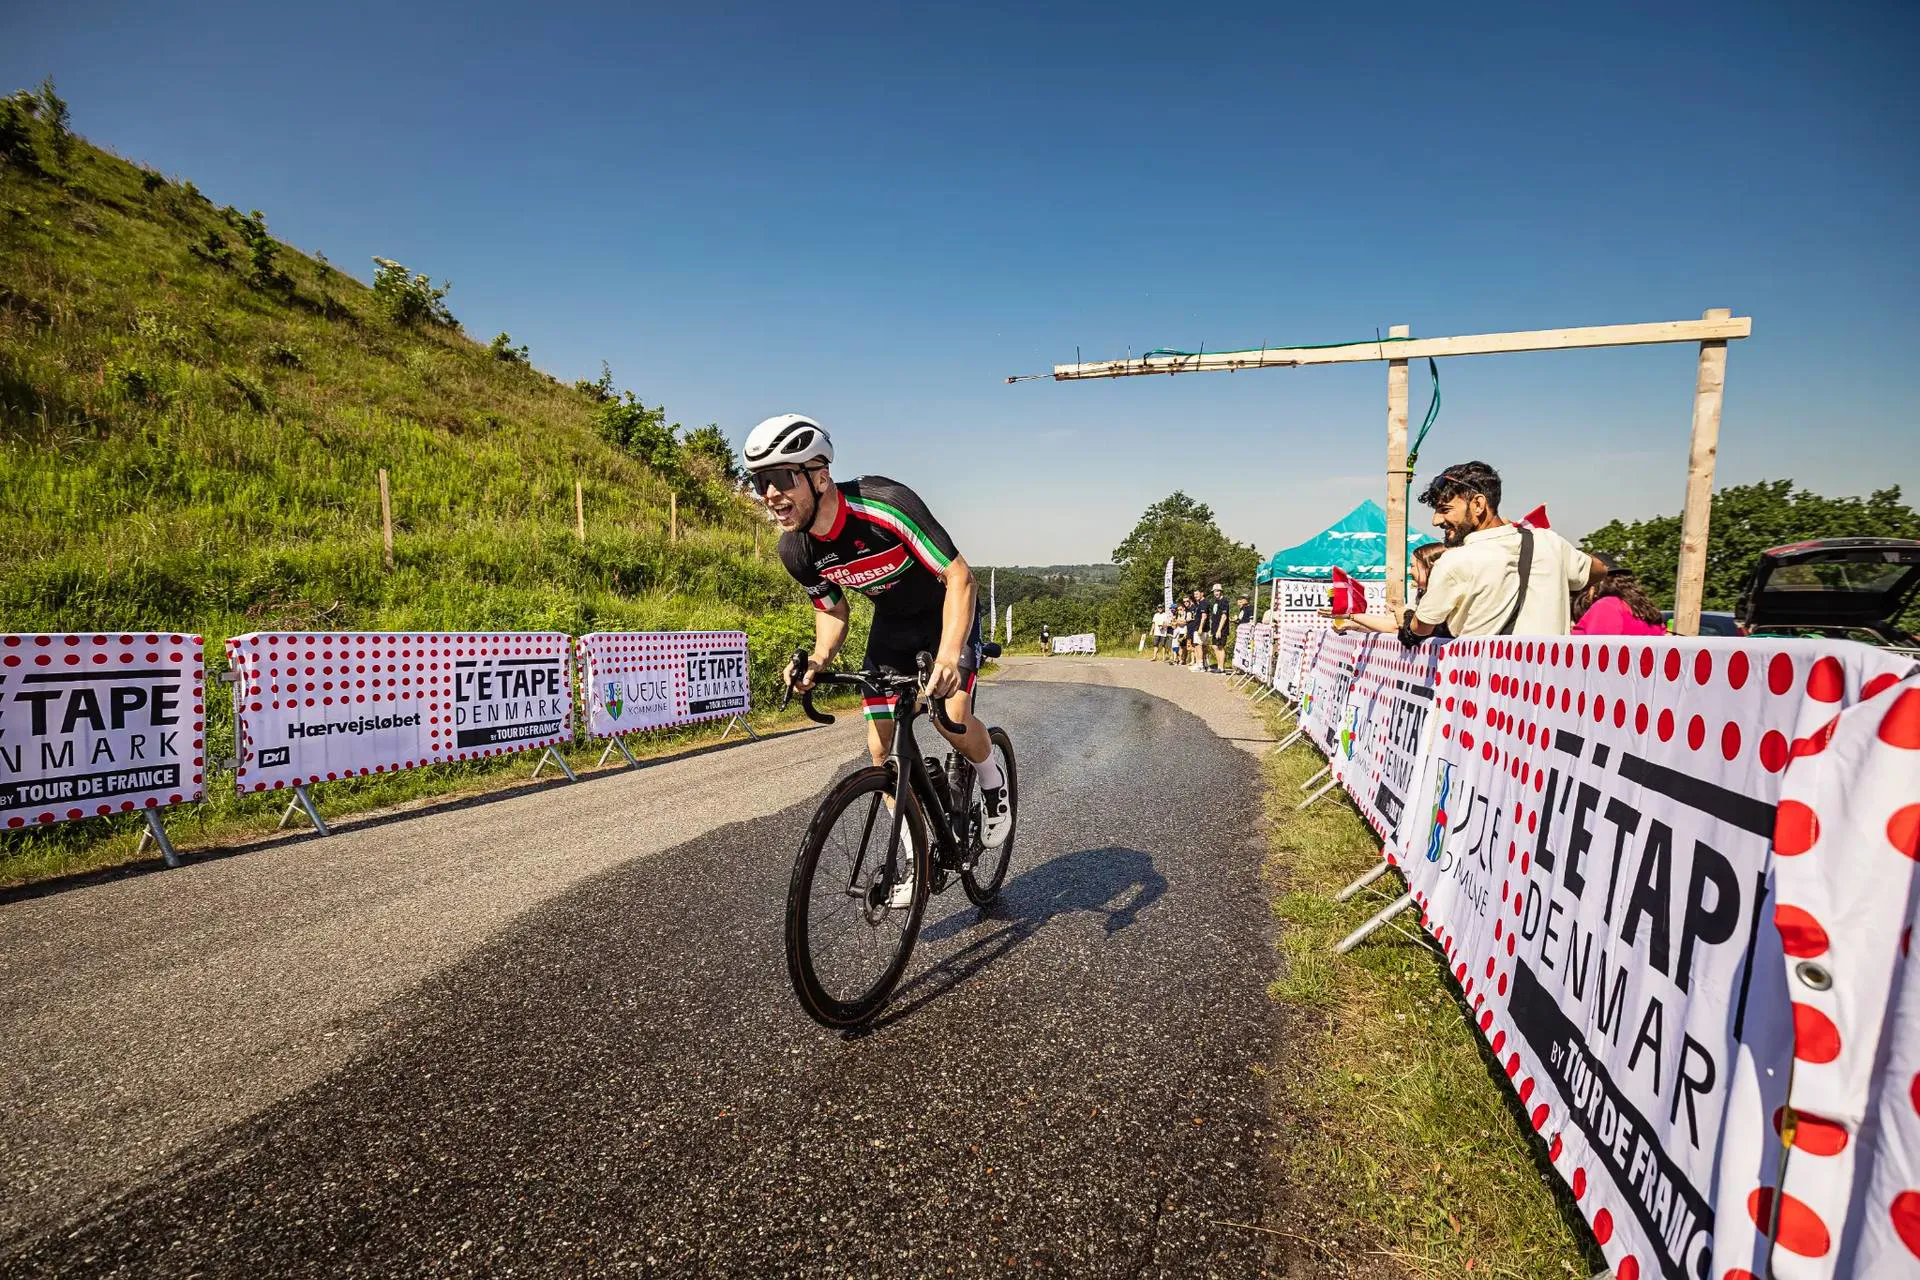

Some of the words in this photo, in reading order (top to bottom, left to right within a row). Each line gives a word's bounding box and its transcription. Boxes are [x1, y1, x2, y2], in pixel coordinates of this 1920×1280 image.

[627, 681, 668, 702] VEJLE
[688, 681, 744, 698] DENMARK
[0, 684, 181, 738] TAPE
[456, 698, 562, 725] DENMARK
[628, 703, 668, 715] KOMMUNE
[288, 713, 421, 739] Hærvejsløbet
[497, 728, 520, 740] TOUR
[519, 726, 530, 737] DE
[17, 781, 73, 803] TOUR
[77, 777, 103, 796] DE
[107, 769, 174, 791] FRANCE
[1521, 880, 1716, 1150] DENMAR
[1550, 1039, 1565, 1070] BY
[1599, 1105, 1633, 1170] DE
[1628, 1135, 1714, 1280] FRANC
